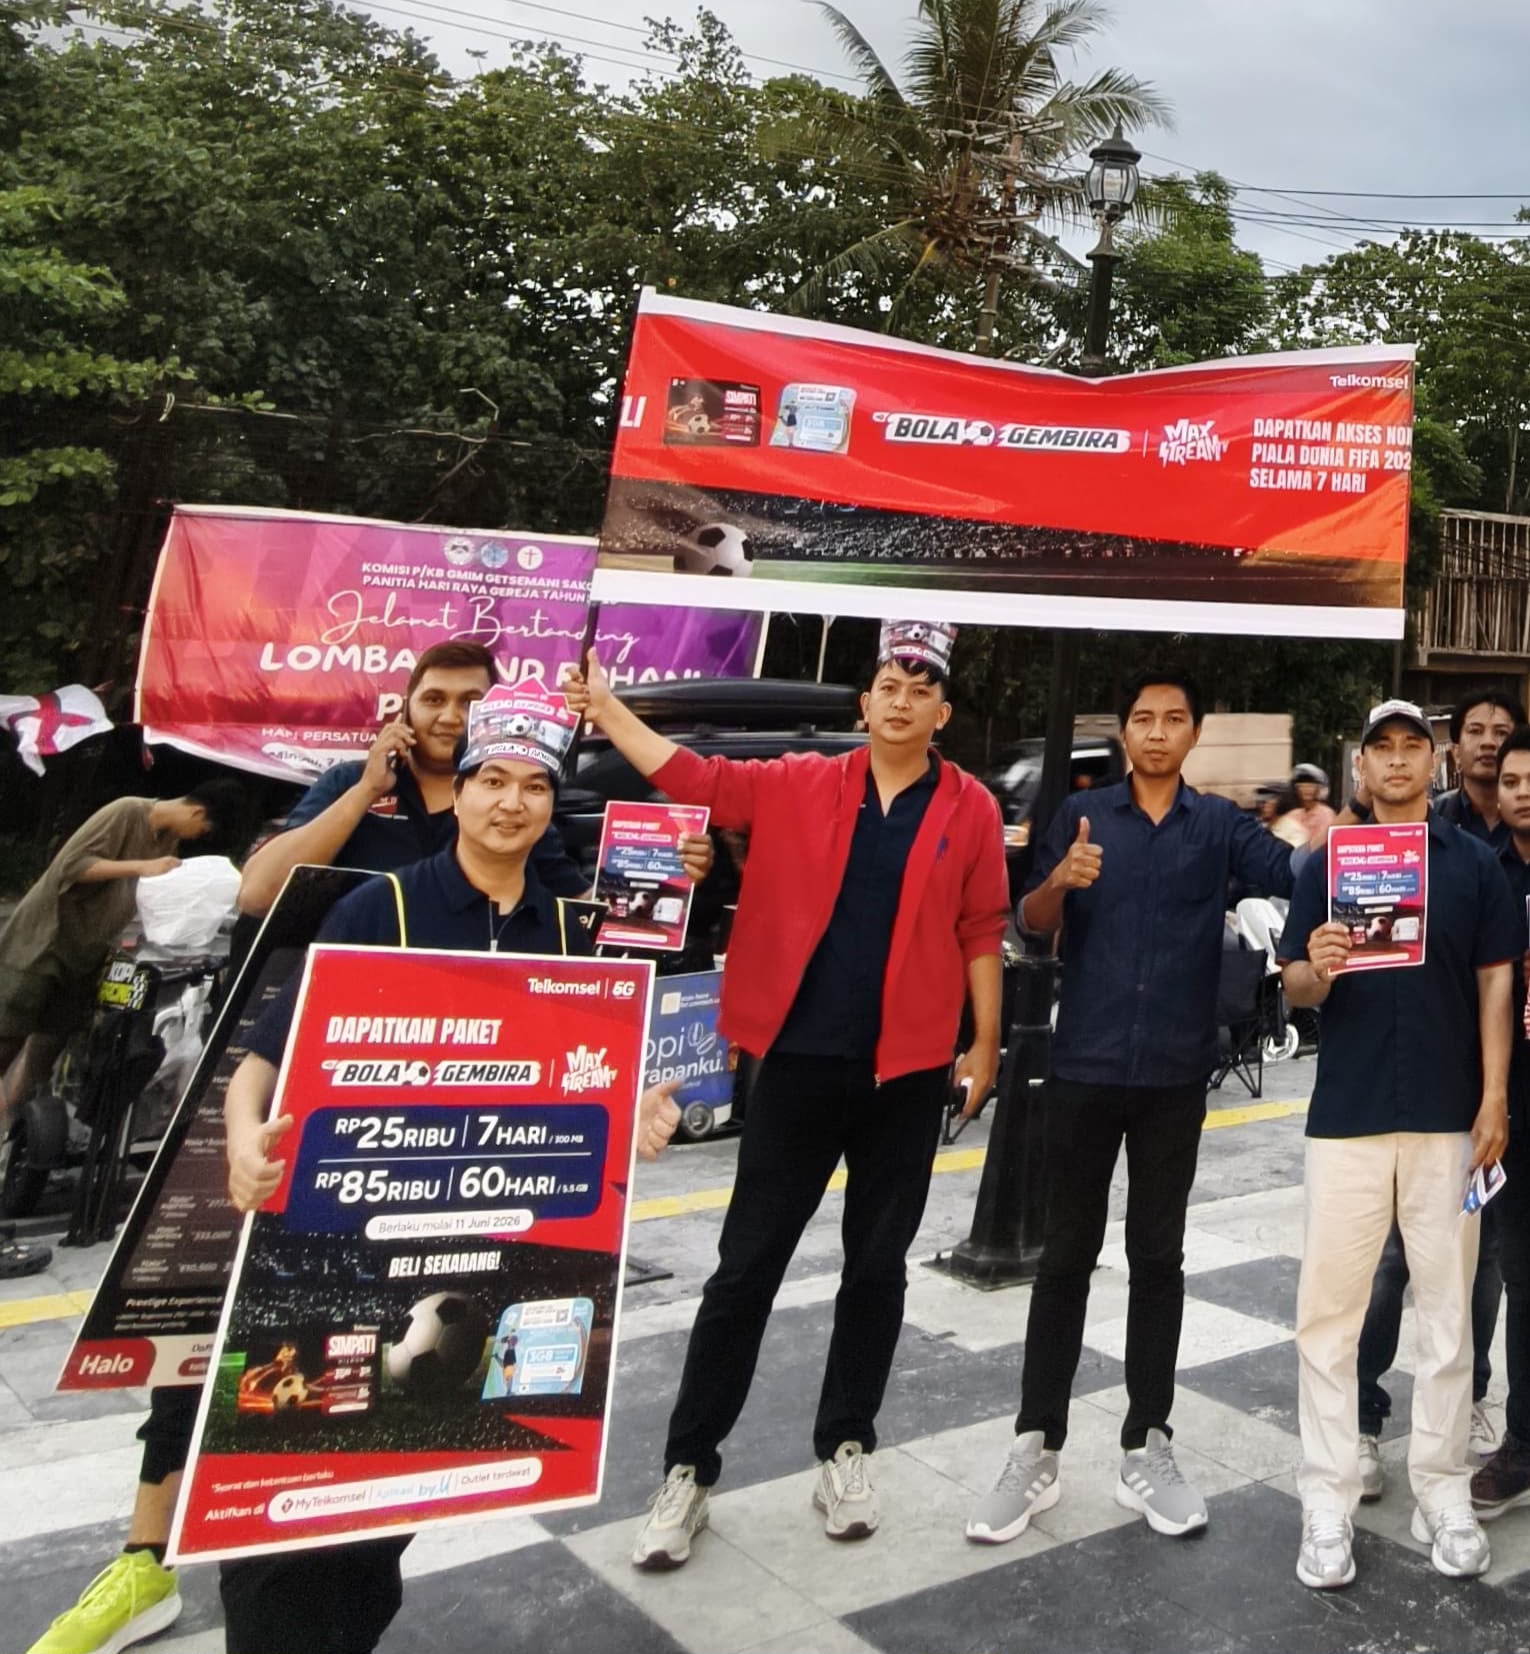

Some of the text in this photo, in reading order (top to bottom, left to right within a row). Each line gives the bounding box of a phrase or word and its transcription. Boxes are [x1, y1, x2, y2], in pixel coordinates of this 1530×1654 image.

[1329, 374, 1408, 389] Telkomsel
[894, 416, 1120, 450] BOLA GEMBIRA
[1253, 418, 1332, 441] DAPATKAN
[1335, 422, 1382, 445] AKSES
[1251, 443, 1295, 464] PIALA
[1299, 446, 1344, 467] DUNIA
[1348, 449, 1380, 469] FIFA
[1249, 468, 1366, 493] SELAMA 7 HARI
[362, 562, 410, 576] KOMISI
[412, 566, 445, 579] P/KB
[447, 569, 484, 582] GMIM
[485, 572, 561, 589] GETSEMANI
[362, 575, 416, 590] PANITIA
[418, 578, 450, 592] HARI
[452, 582, 488, 595] RAYA
[490, 586, 540, 599] GEREJA
[542, 590, 586, 603] TAHUN
[259, 643, 416, 677] LOMBA
[527, 978, 600, 995] Telkomsel
[325, 1016, 503, 1045] DAPATKAN PAKET
[341, 1063, 532, 1082] BOLA GEMBIRA
[378, 1221, 421, 1234] Berlaku
[455, 1219, 465, 1230] 11
[467, 1217, 491, 1230] Juni
[493, 1215, 520, 1228] 2026
[388, 1251, 502, 1278] BELI SEKARANG!
[328, 1334, 376, 1357] SIMPATI
[78, 1353, 135, 1375] Halo
[204, 1504, 252, 1521] Aktifkan
[253, 1502, 265, 1515] di
[461, 1473, 491, 1486] Outlet
